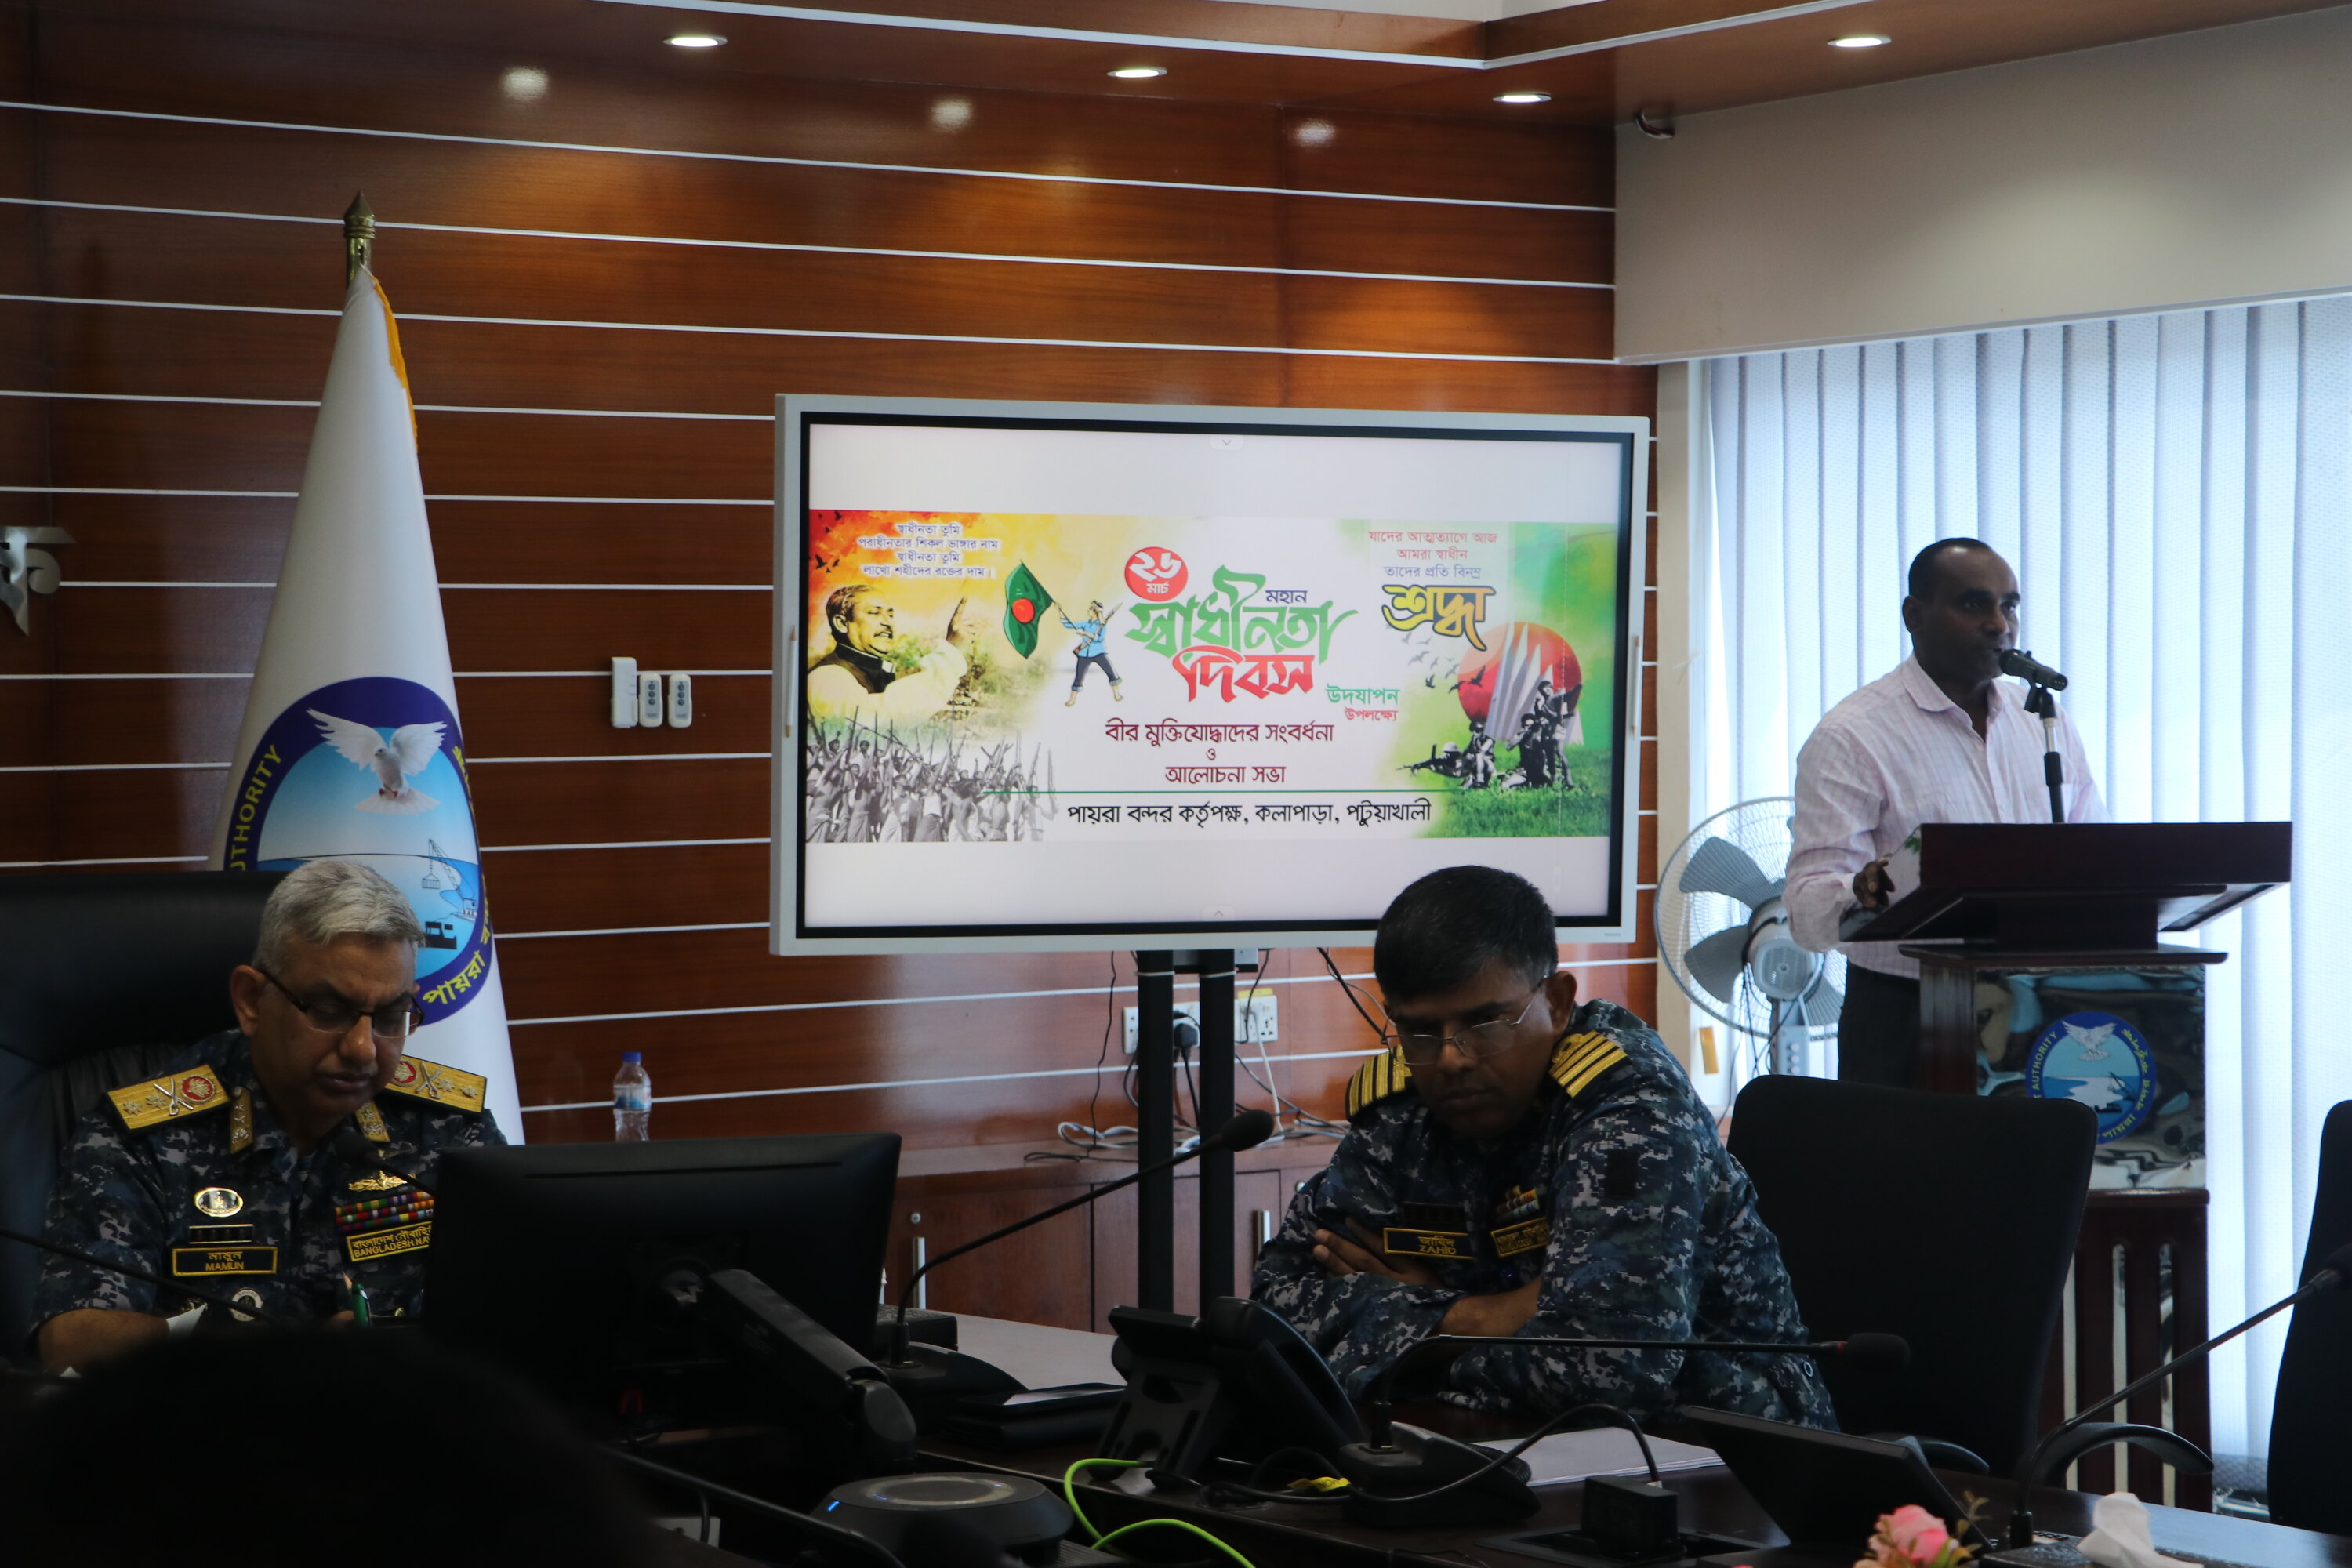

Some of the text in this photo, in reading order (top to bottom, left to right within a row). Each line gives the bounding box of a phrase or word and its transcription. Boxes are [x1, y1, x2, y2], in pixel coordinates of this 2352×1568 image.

[897, 522, 960, 536] স্বাধীনতা তুমি
[858, 535, 997, 549] পরাধীনতার শিকল ভাঙ্গার নাম
[1368, 532, 1403, 543] যাদের
[1473, 532, 1498, 543] আজ
[897, 550, 960, 564] স্বাধীনতা তুমি
[1396, 546, 1468, 560] আমরা স্বাধীন
[863, 566, 889, 575] লাখো
[895, 564, 931, 576] শহীদের
[935, 567, 963, 576] রক্তের
[1129, 551, 1182, 582] ২৬
[1385, 564, 1482, 579] তাদের প্রতি বিনম্র
[1146, 582, 1169, 594] মার্চ
[1265, 590, 1308, 604] মহান
[1124, 564, 1359, 664] স্বাধীনতা
[1381, 584, 1497, 651] শ্রদ্ধা
[1172, 646, 1316, 702] দিবস
[1325, 684, 1399, 705] উদযাপন
[1105, 717, 1334, 746] বীর মুক্তিযোদ্ধাদের সংবর্ধনা
[1206, 748, 1217, 760] ও
[1165, 766, 1286, 784] আলোচনা সভা
[230, 745, 282, 871] UTHORITY
[1067, 797, 1432, 828] পায়রা বন্দর কর্তৃপক্ষ, কলাপাড়া, পটুয়াখালী
[422, 949, 487, 1005] পায়রা
[2032, 1030, 2057, 1091] AUTHORITY
[351, 1226, 432, 1249] বাংলাদেশ নৌবাহি
[354, 1236, 430, 1257] BANGLADESH NA
[1418, 1245, 1457, 1254] ZAHID
[208, 1251, 243, 1261] মামুন
[205, 1262, 245, 1272] MAMUN
